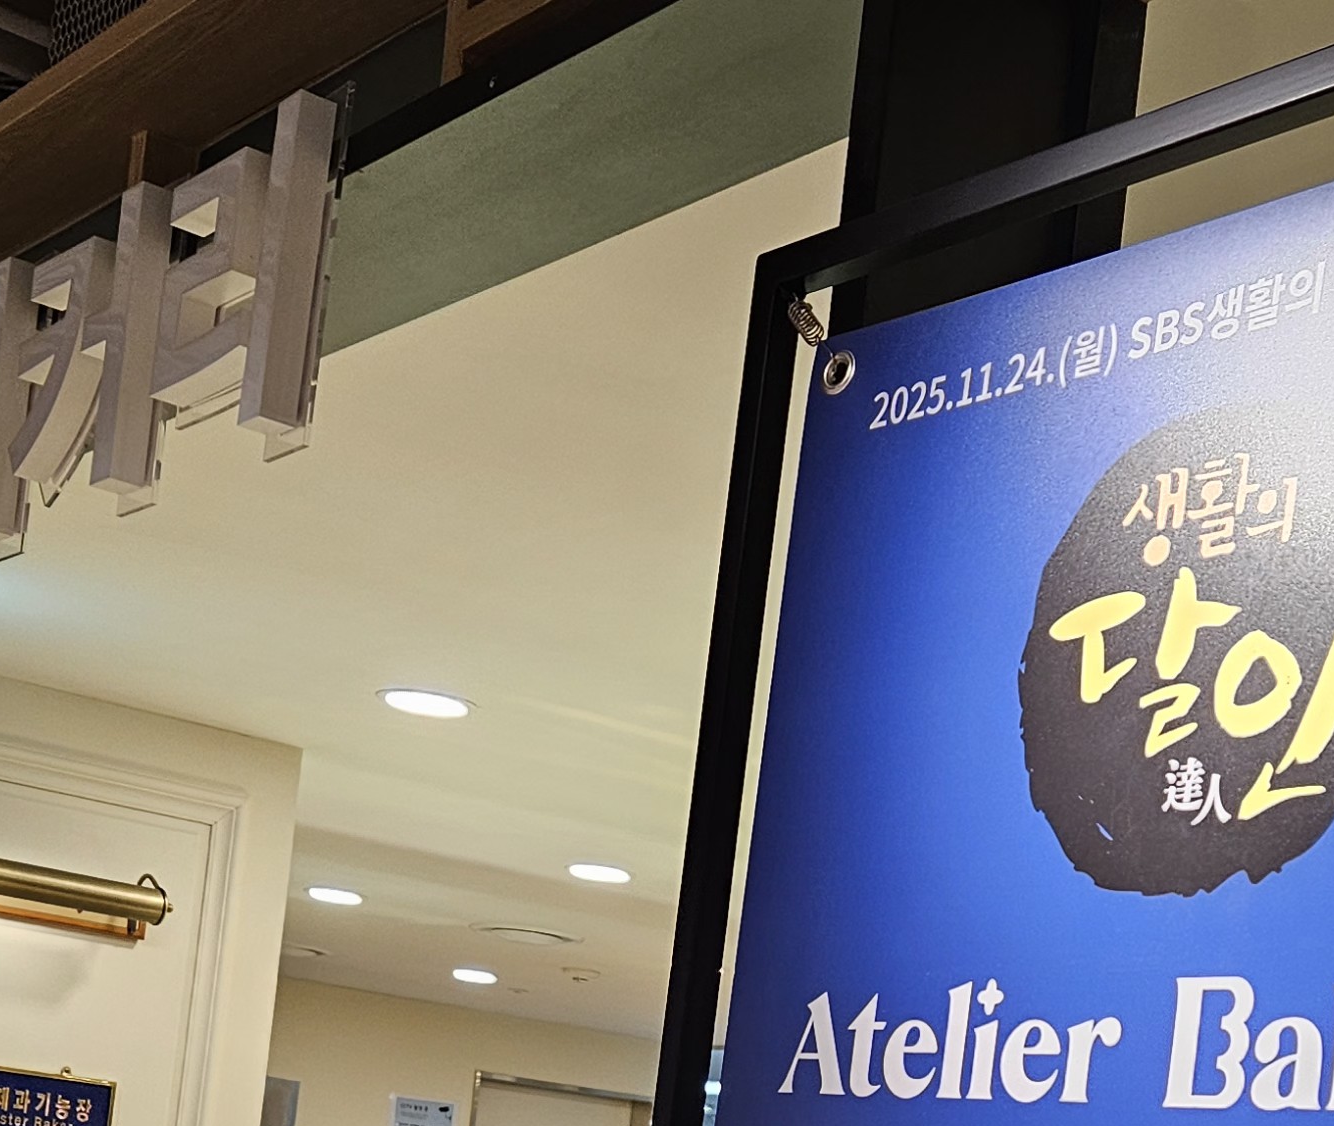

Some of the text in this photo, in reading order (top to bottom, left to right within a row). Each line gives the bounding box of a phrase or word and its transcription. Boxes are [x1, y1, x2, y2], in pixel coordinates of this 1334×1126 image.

[869, 324, 1119, 430] 2025.11.24.(월)
[1128, 262, 1326, 361] SBS생활의
[1123, 453, 1298, 566] 생활의
[1161, 757, 1232, 827] 達人
[777, 976, 1123, 1103] Atelier
